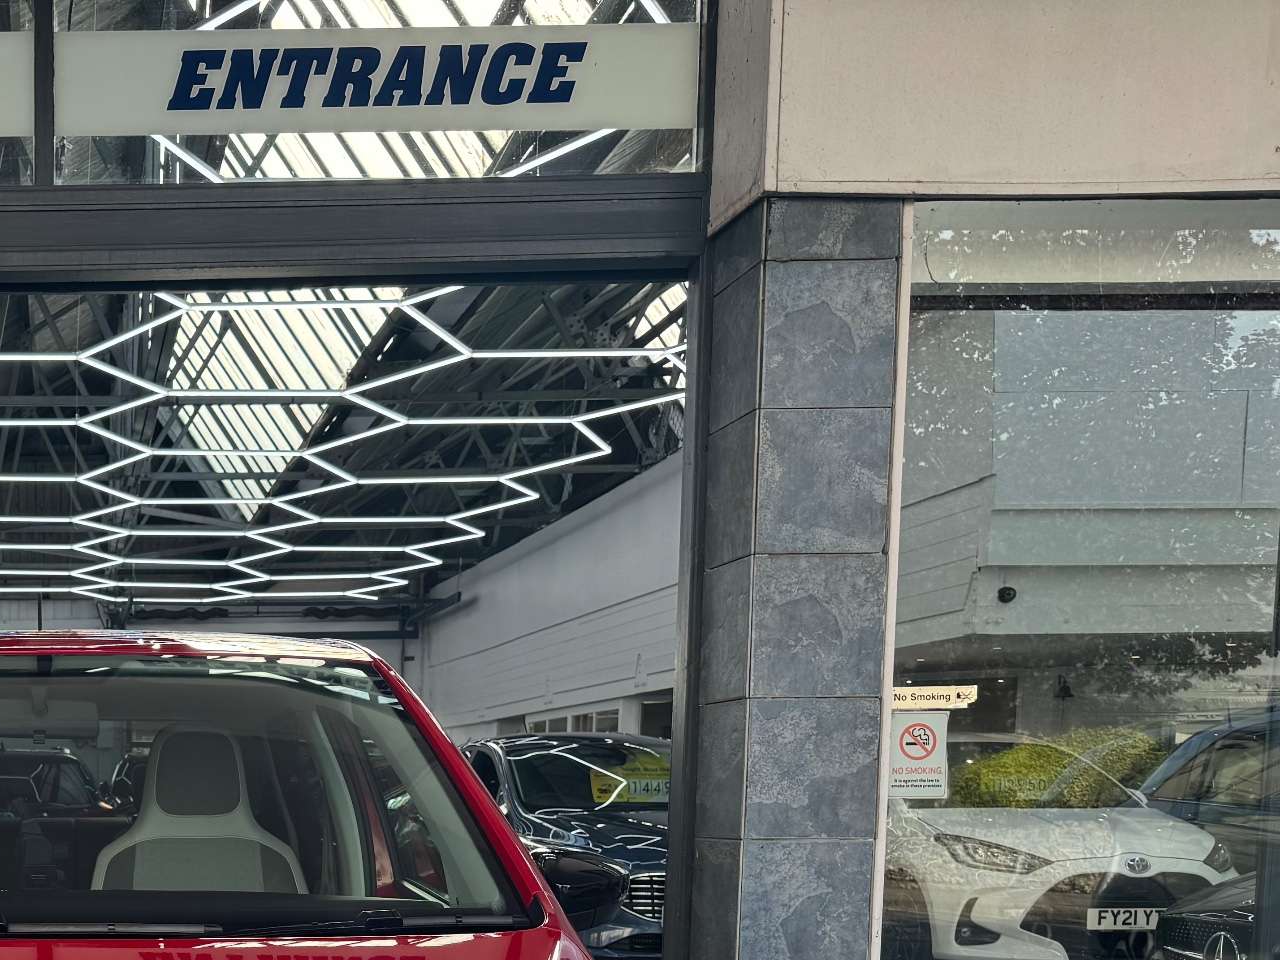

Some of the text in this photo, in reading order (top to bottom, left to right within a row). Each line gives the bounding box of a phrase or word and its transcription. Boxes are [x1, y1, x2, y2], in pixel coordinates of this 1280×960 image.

[166, 41, 588, 111] ENTRANCE
[893, 692, 951, 702] No Smoking
[892, 767, 943, 775] NO SMOKING
[1097, 910, 1137, 926] FY21
